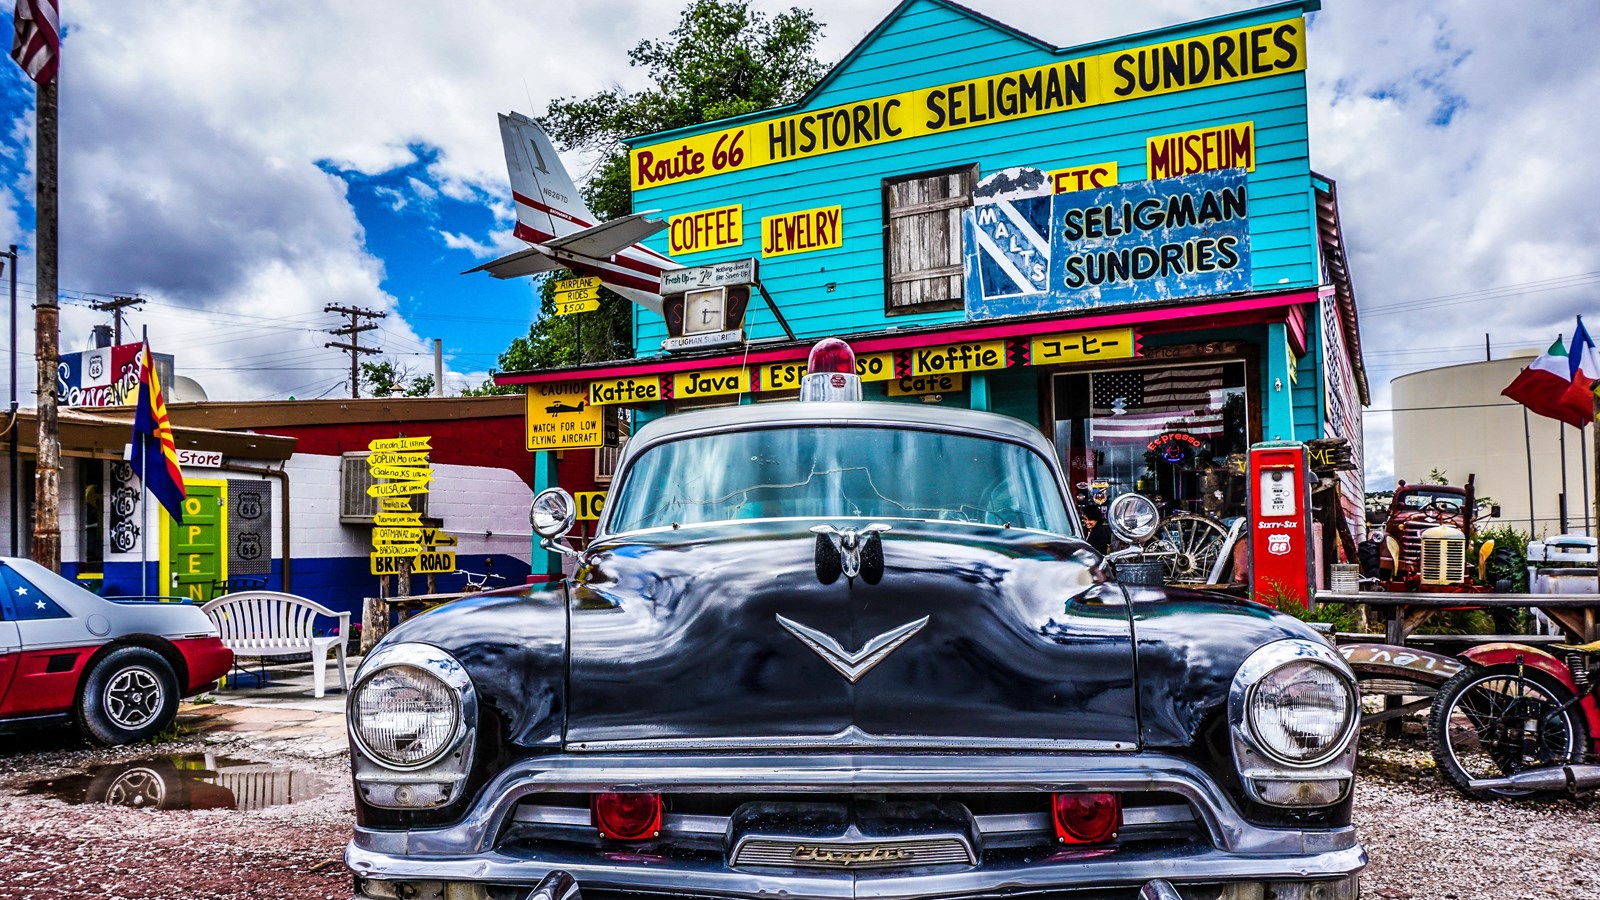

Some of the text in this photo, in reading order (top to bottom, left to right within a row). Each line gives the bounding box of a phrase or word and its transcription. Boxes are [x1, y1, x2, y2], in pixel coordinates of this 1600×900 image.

[637, 24, 1298, 186] Route 66 HISTORIC SELIGMAN SUNDRIES
[1150, 126, 1251, 180] MUSEUM
[1063, 186, 1247, 242] SELIGMAN
[671, 208, 738, 250] COFFEE
[764, 209, 839, 254] JEWELRY
[1063, 237, 1238, 290] SUNDRIES
[560, 277, 594, 289] AIRPLANE
[567, 290, 589, 301] RIDES
[563, 302, 585, 313] $5.00
[1042, 335, 1119, 359] コーヒー
[917, 344, 999, 373] Koffie
[91, 364, 100, 374] 66
[592, 380, 657, 403] Kaffee
[684, 372, 740, 395] Java
[533, 420, 597, 433] WATCH FOR LOW
[531, 432, 598, 446] FLYING AIRCRAFT
[1147, 433, 1201, 451] Espresso
[178, 451, 220, 466] Store
[119, 462, 131, 478] 66
[119, 498, 131, 512] 66
[242, 502, 257, 515] 66
[119, 531, 131, 546] 66
[1271, 542, 1287, 552] 66
[185, 497, 203, 601] OPEN
[242, 542, 257, 555] 66
[420, 553, 451, 571] ROAD
[790, 844, 915, 866] Chrysler
